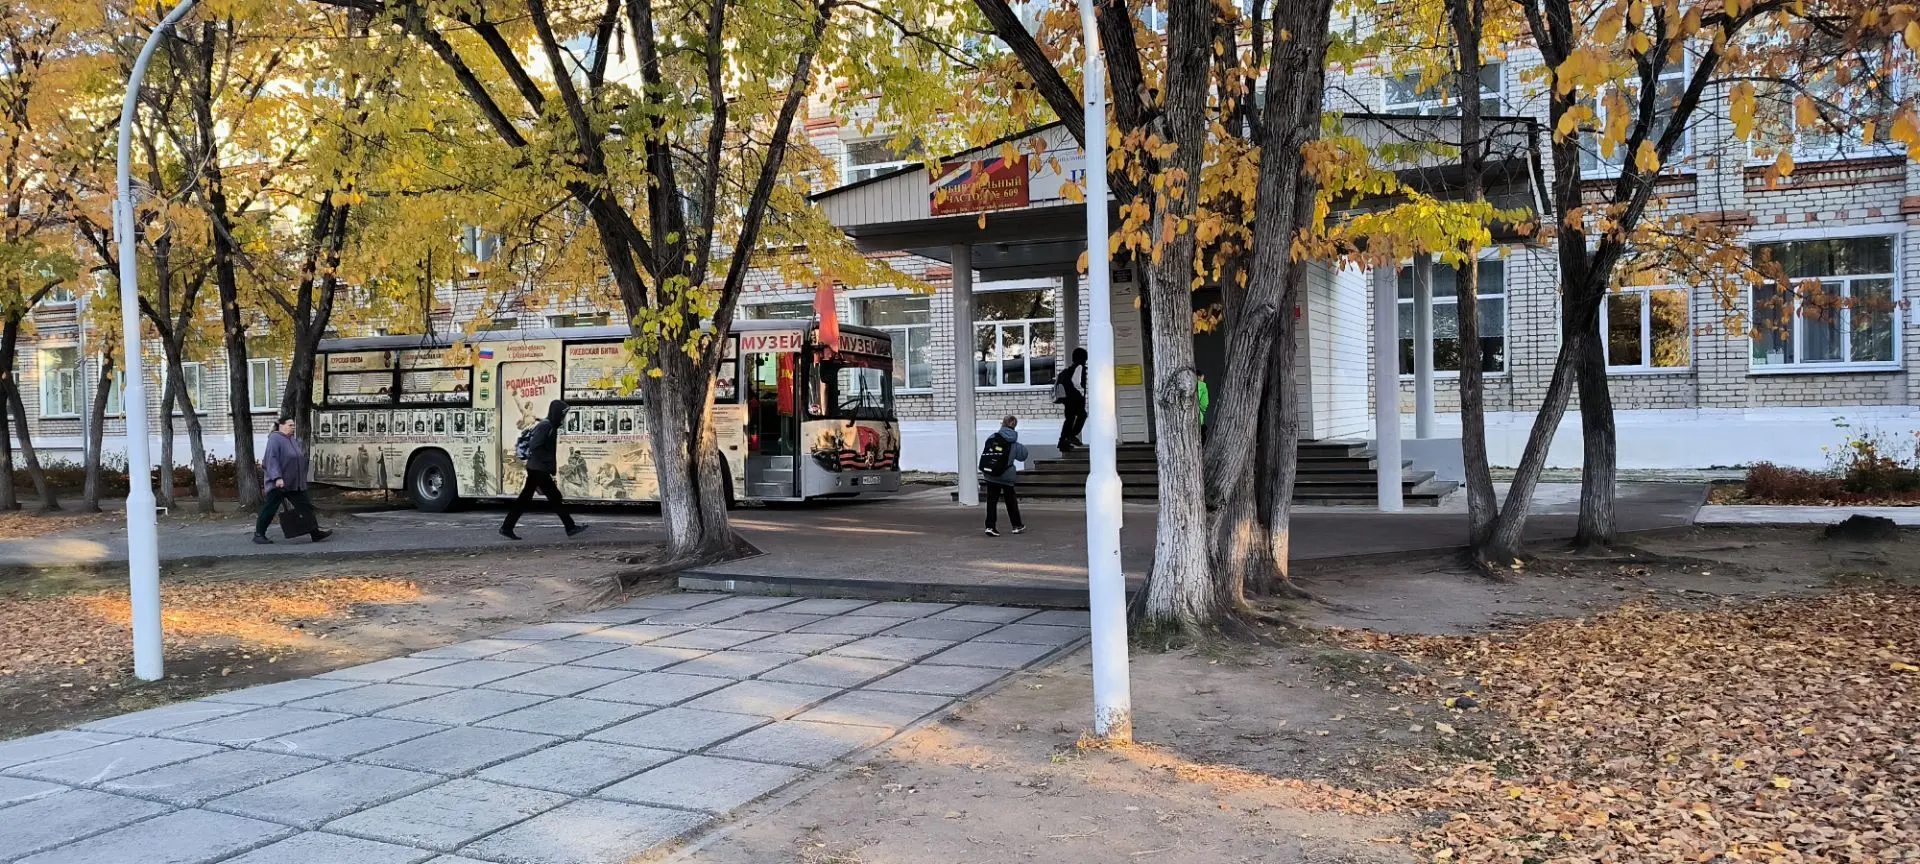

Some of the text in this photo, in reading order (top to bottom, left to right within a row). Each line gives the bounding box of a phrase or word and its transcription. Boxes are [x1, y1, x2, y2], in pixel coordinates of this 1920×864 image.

[1003, 187, 1019, 198] 609
[741, 332, 801, 350] МУЗЕЙ
[839, 335, 881, 354] МУЗЕЙ
[600, 347, 619, 355] БИТВА
[505, 374, 557, 390] РОДИНА-МАТЬ
